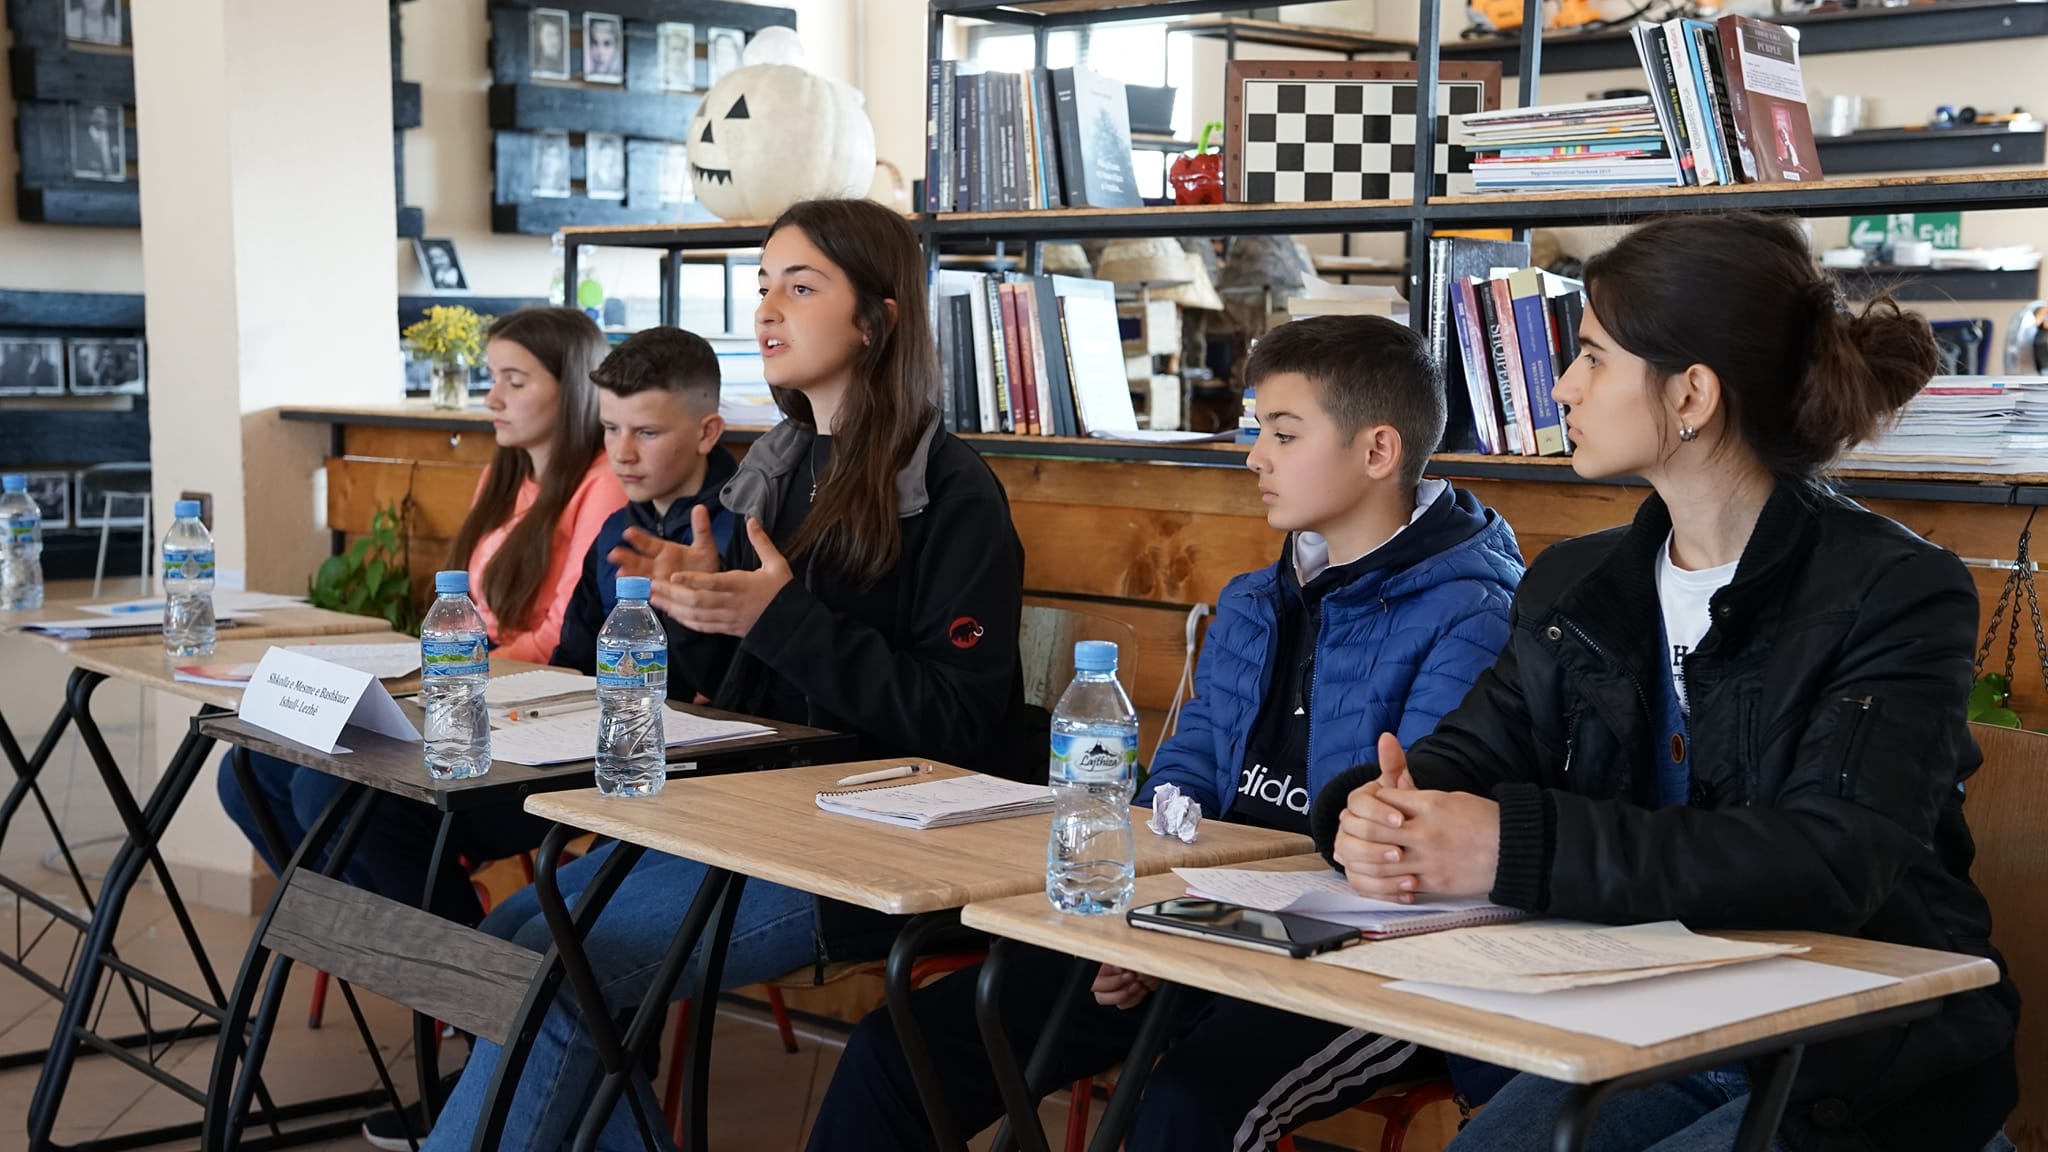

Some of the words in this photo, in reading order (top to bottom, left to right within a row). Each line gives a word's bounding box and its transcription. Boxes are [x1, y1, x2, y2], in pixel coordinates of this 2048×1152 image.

[1919, 223, 1957, 248] Exit
[268, 672, 290, 688] Shkolla
[295, 680, 315, 696] Mesme
[320, 688, 350, 704] Bashkuar
[1238, 764, 1310, 815] dida
